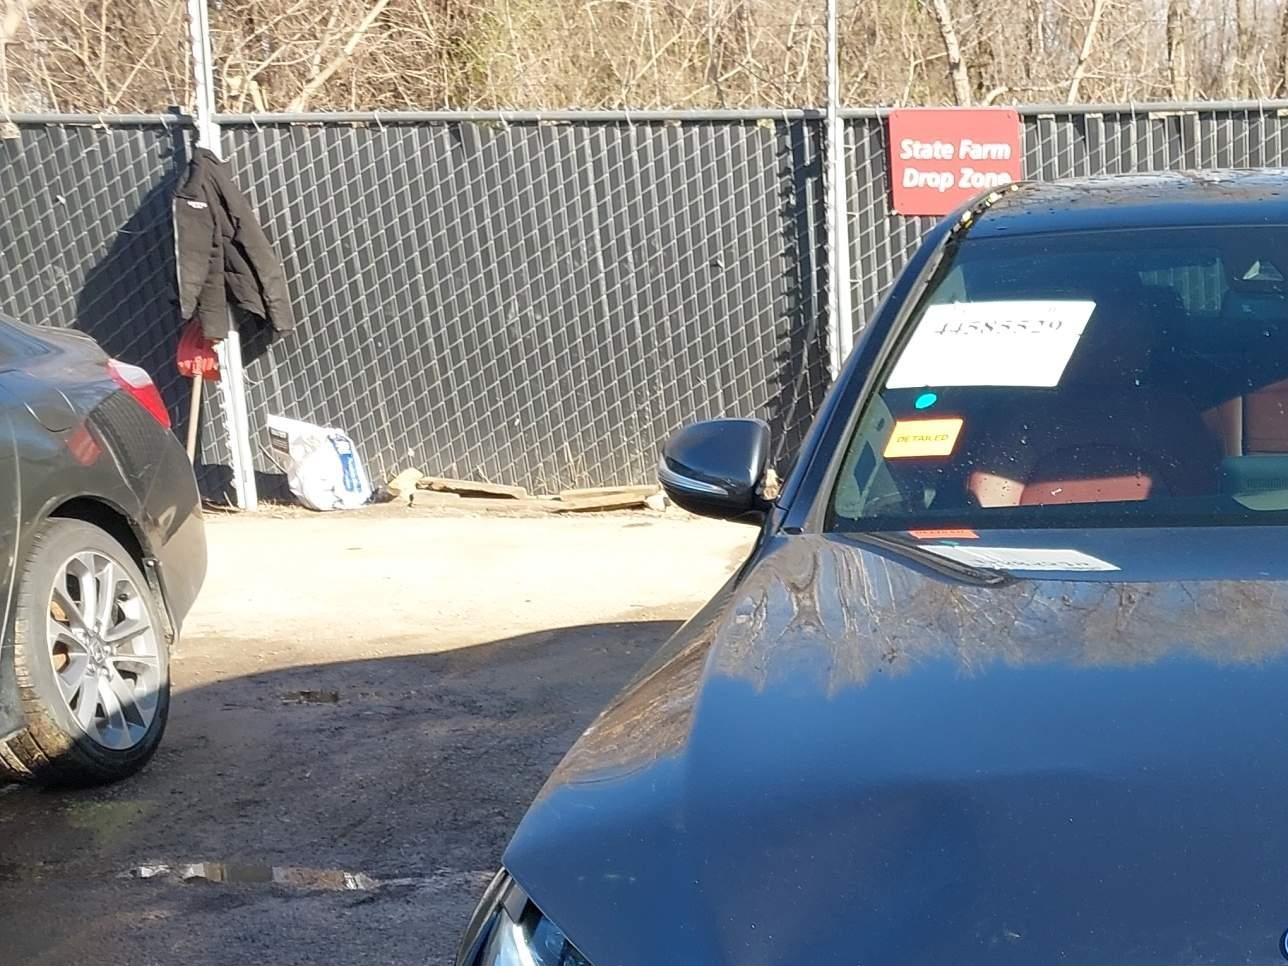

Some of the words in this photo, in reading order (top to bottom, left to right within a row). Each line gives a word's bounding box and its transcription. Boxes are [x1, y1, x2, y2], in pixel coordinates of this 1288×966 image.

[901, 139, 954, 159] State
[959, 139, 1011, 159] Farm
[902, 167, 955, 192] Drop
[958, 167, 1012, 189] Zone
